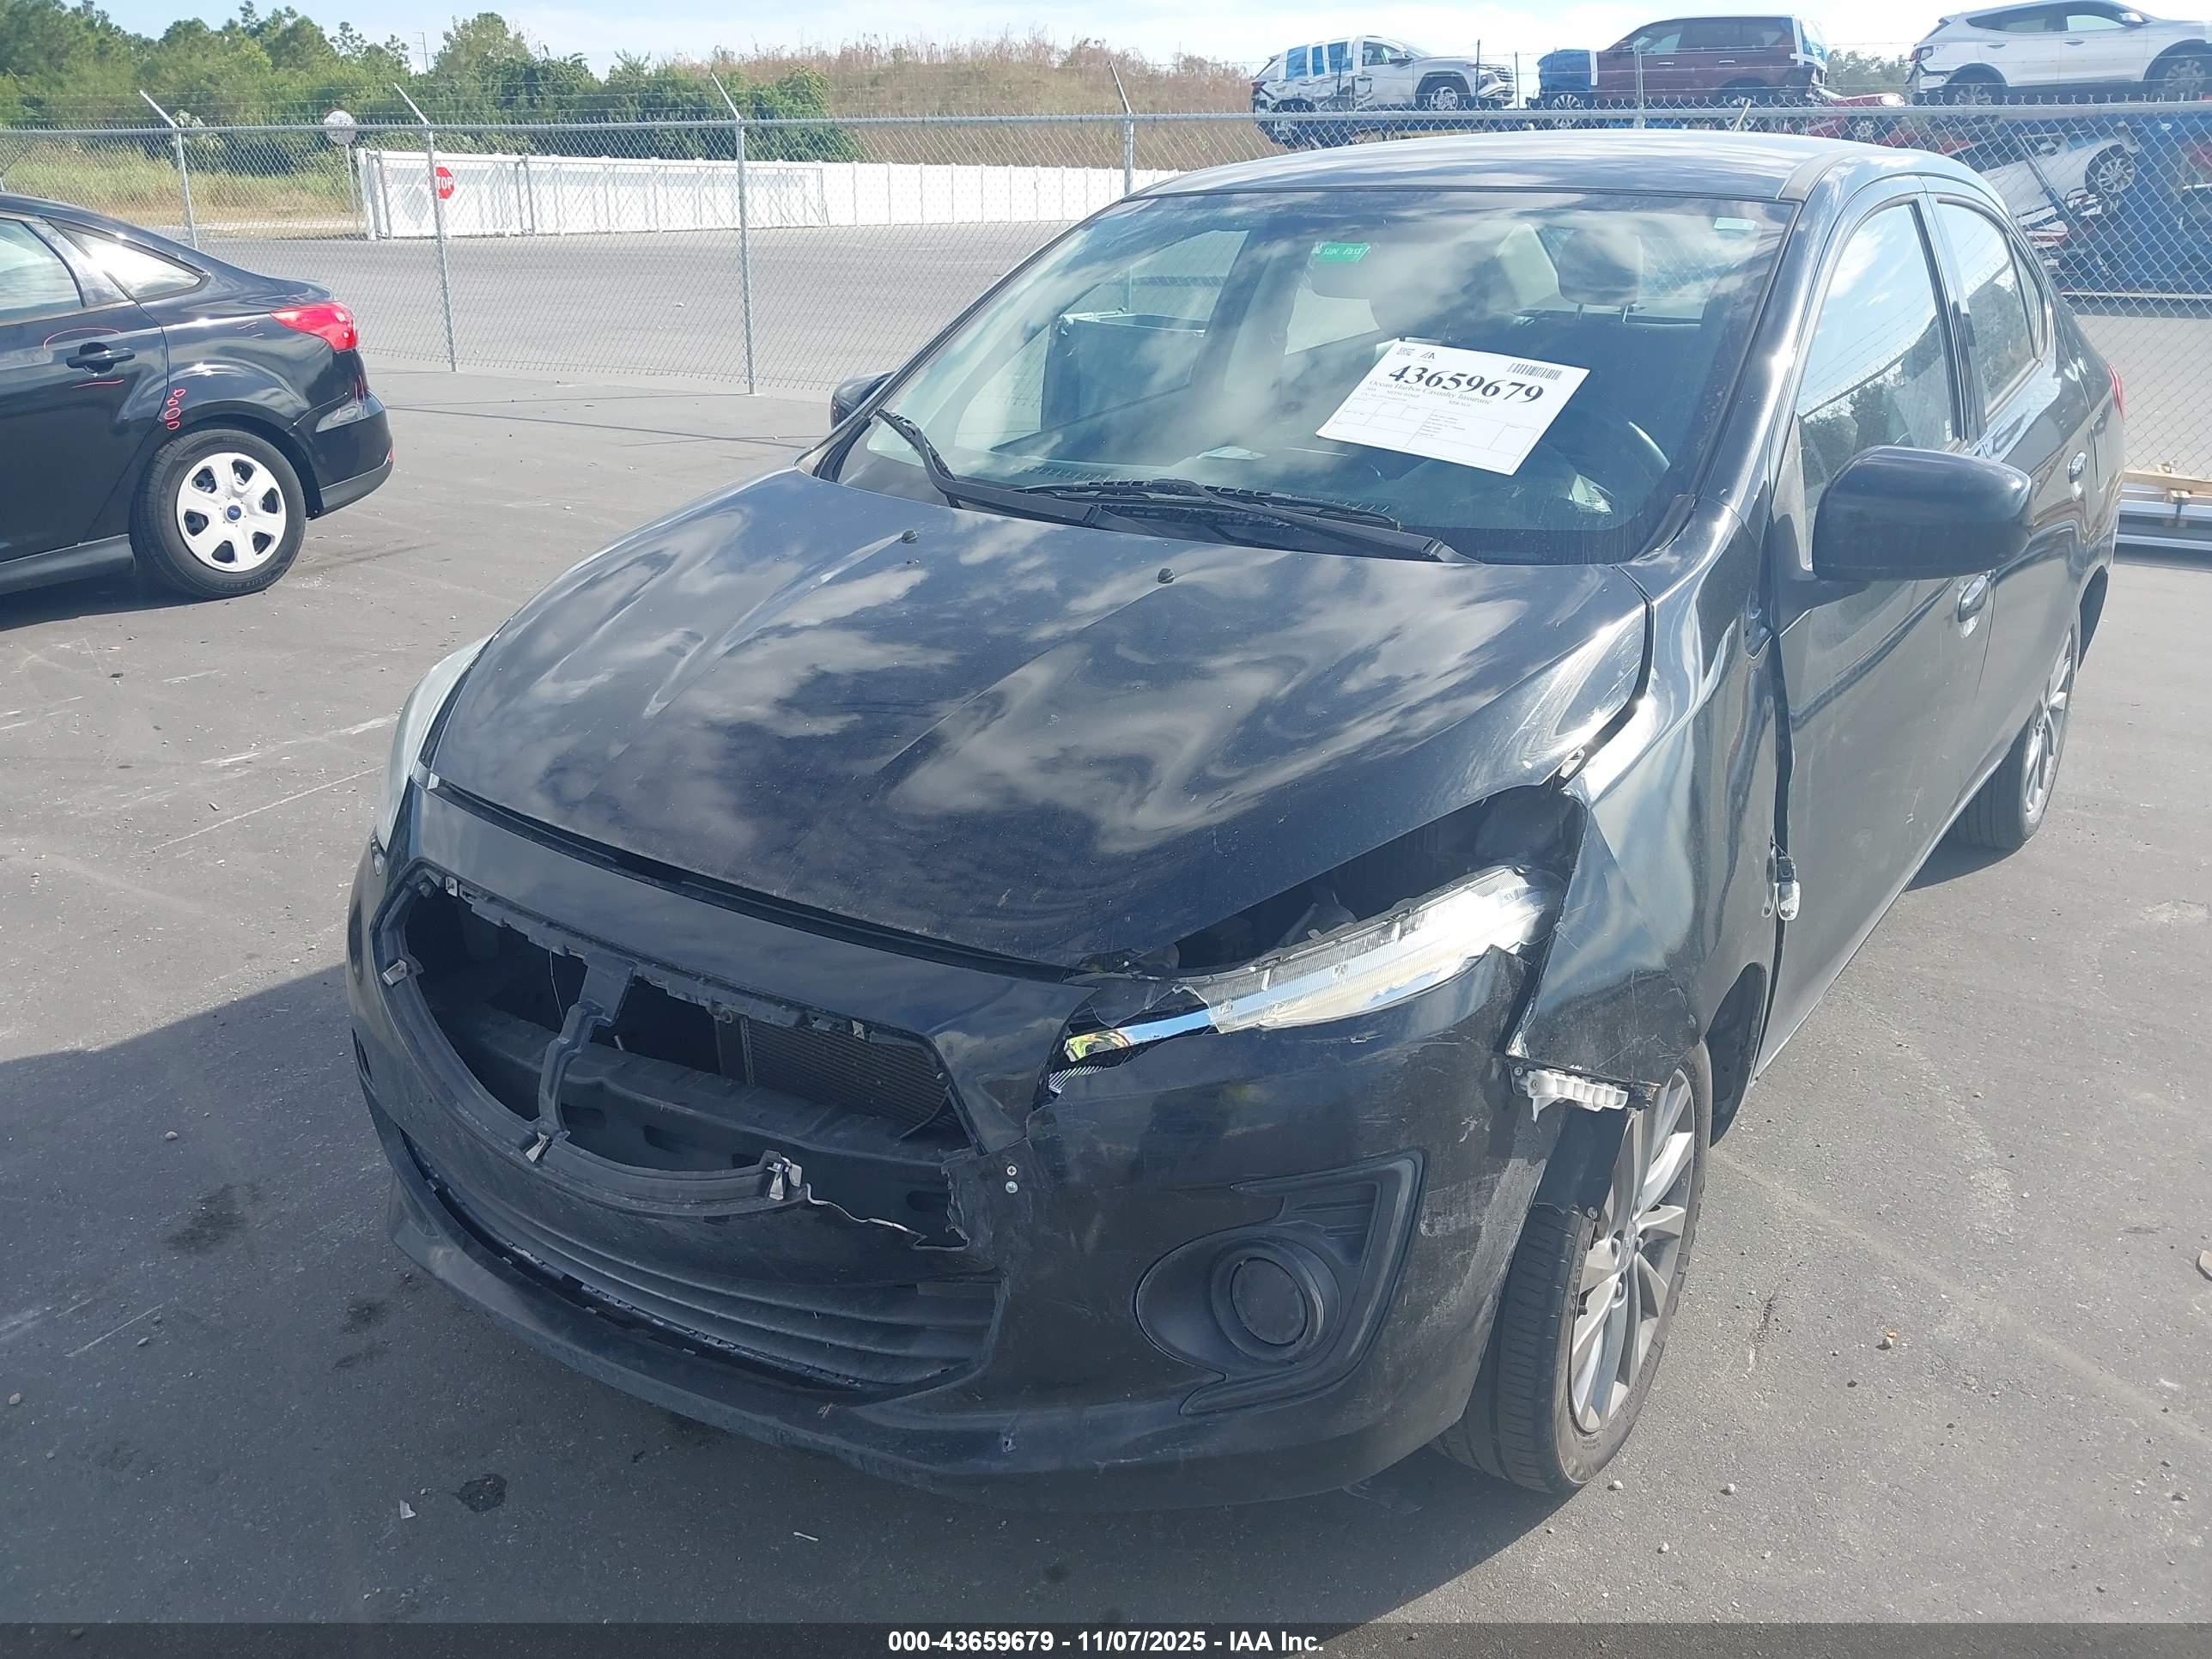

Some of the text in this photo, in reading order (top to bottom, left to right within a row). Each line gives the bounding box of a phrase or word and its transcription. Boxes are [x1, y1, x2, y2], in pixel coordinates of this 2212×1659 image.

[435, 176, 453, 190] TOP
[1389, 365, 1544, 404] 43659679
[1395, 382, 1421, 392] Harbor
[1422, 387, 1457, 399] Casualty
